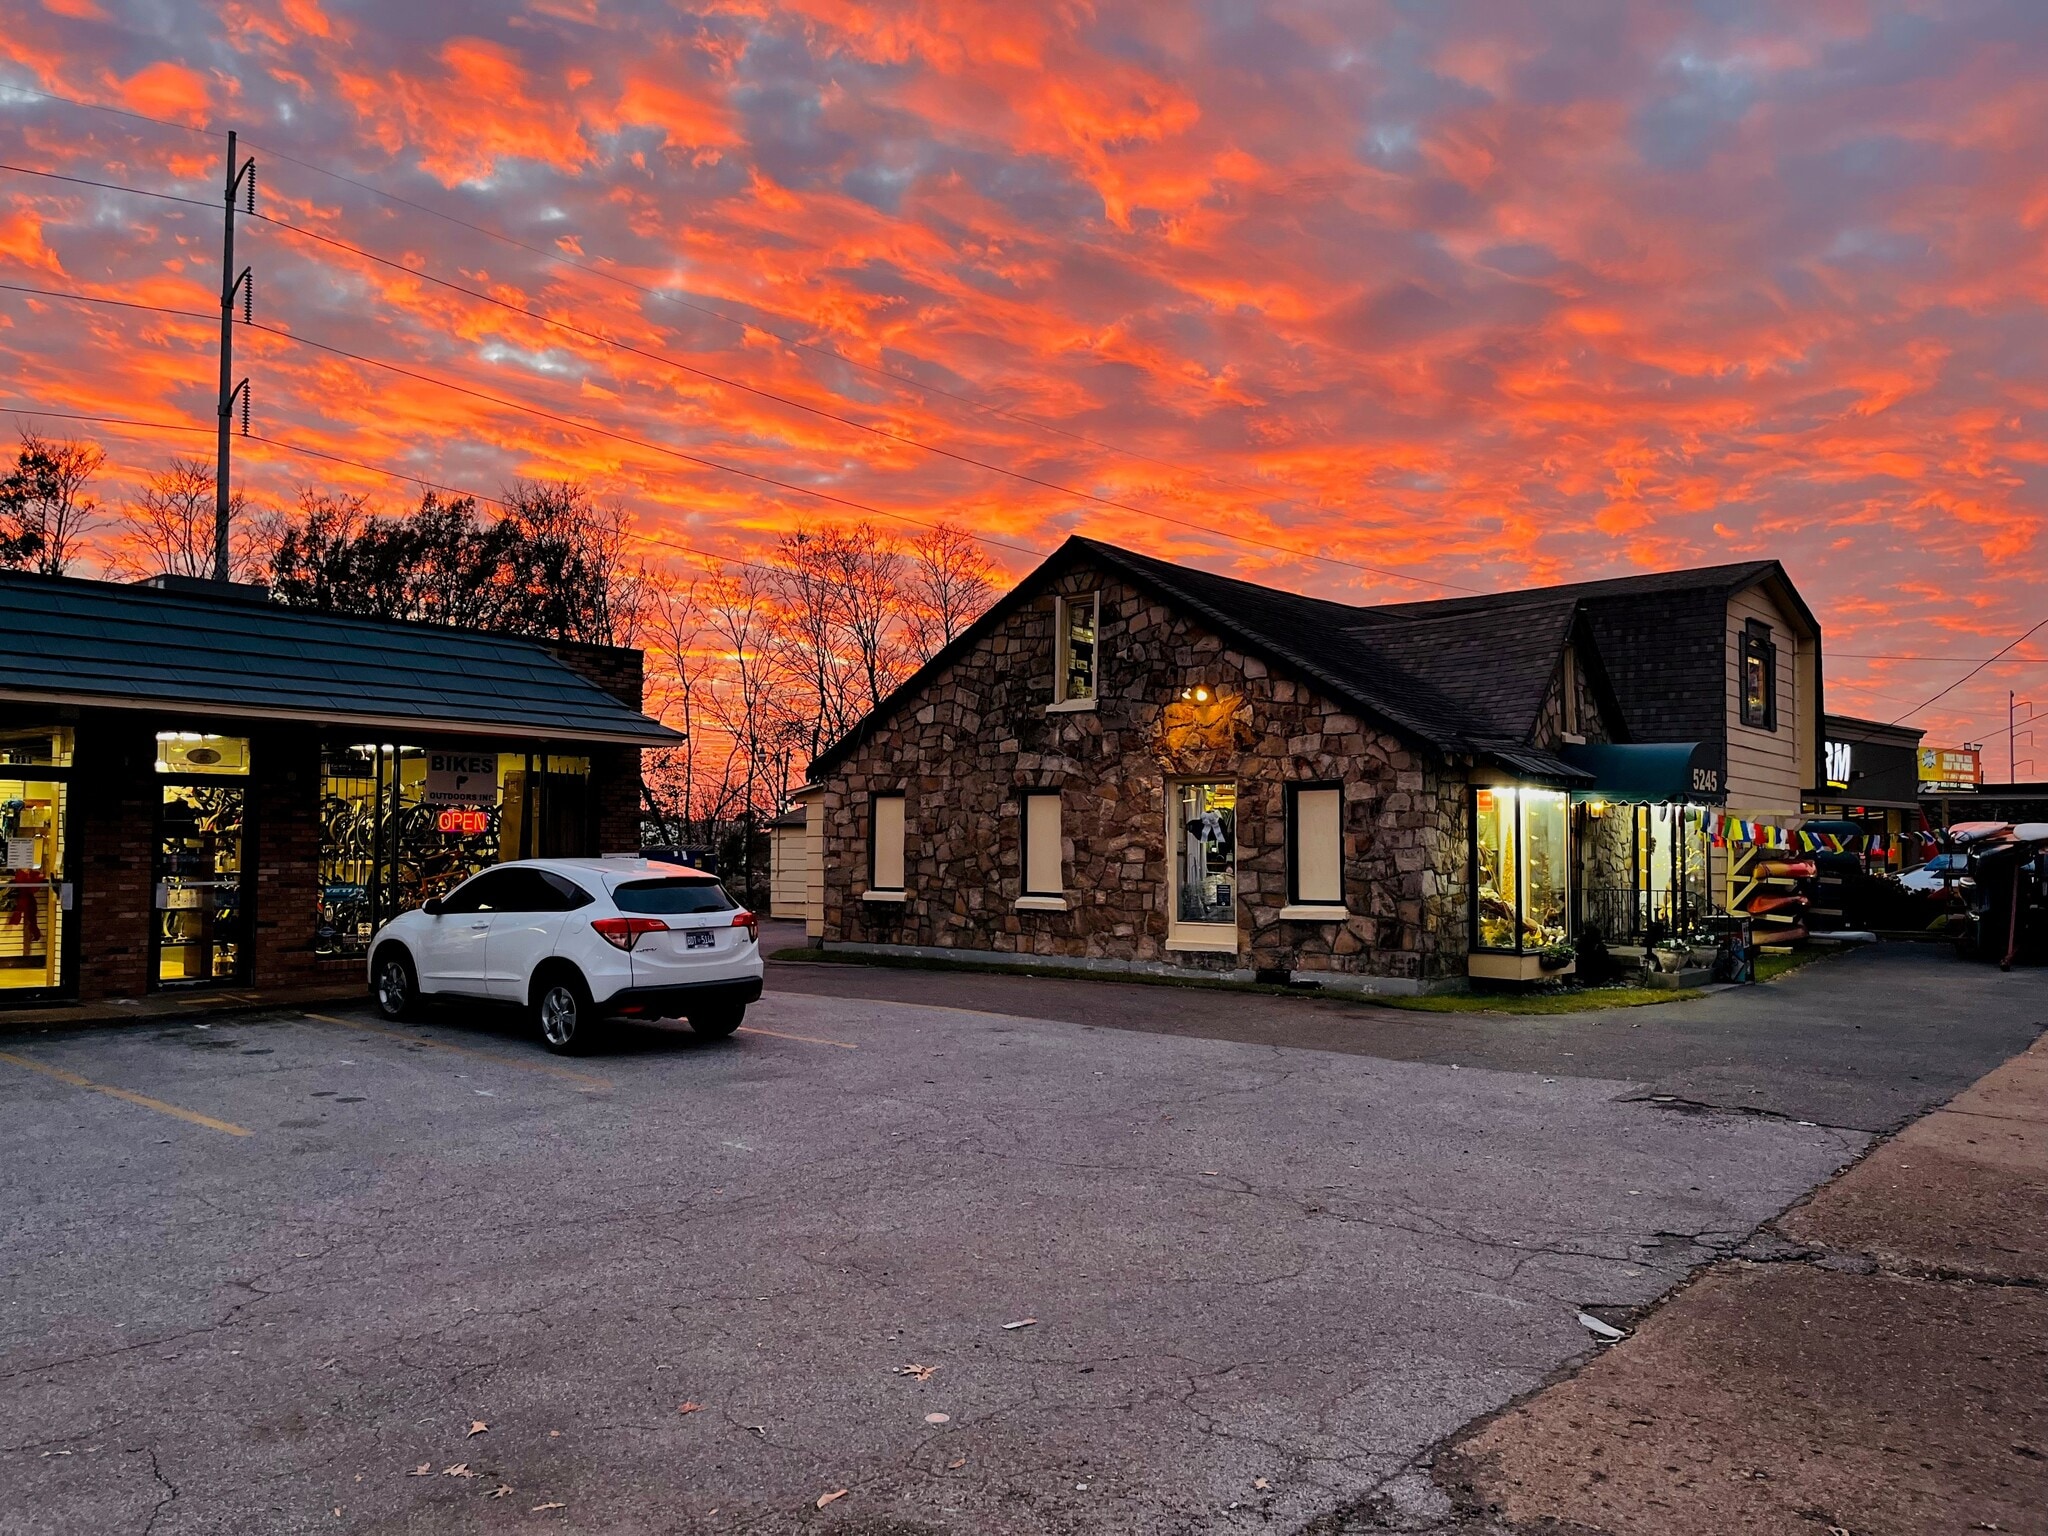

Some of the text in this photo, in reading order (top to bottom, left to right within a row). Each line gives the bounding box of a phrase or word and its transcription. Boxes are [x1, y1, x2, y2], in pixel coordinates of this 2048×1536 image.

[432, 756, 493, 774] BIKES
[1693, 768, 1717, 792] 5245
[430, 792, 477, 801] OUTDOORS
[439, 812, 485, 830] OPEN
